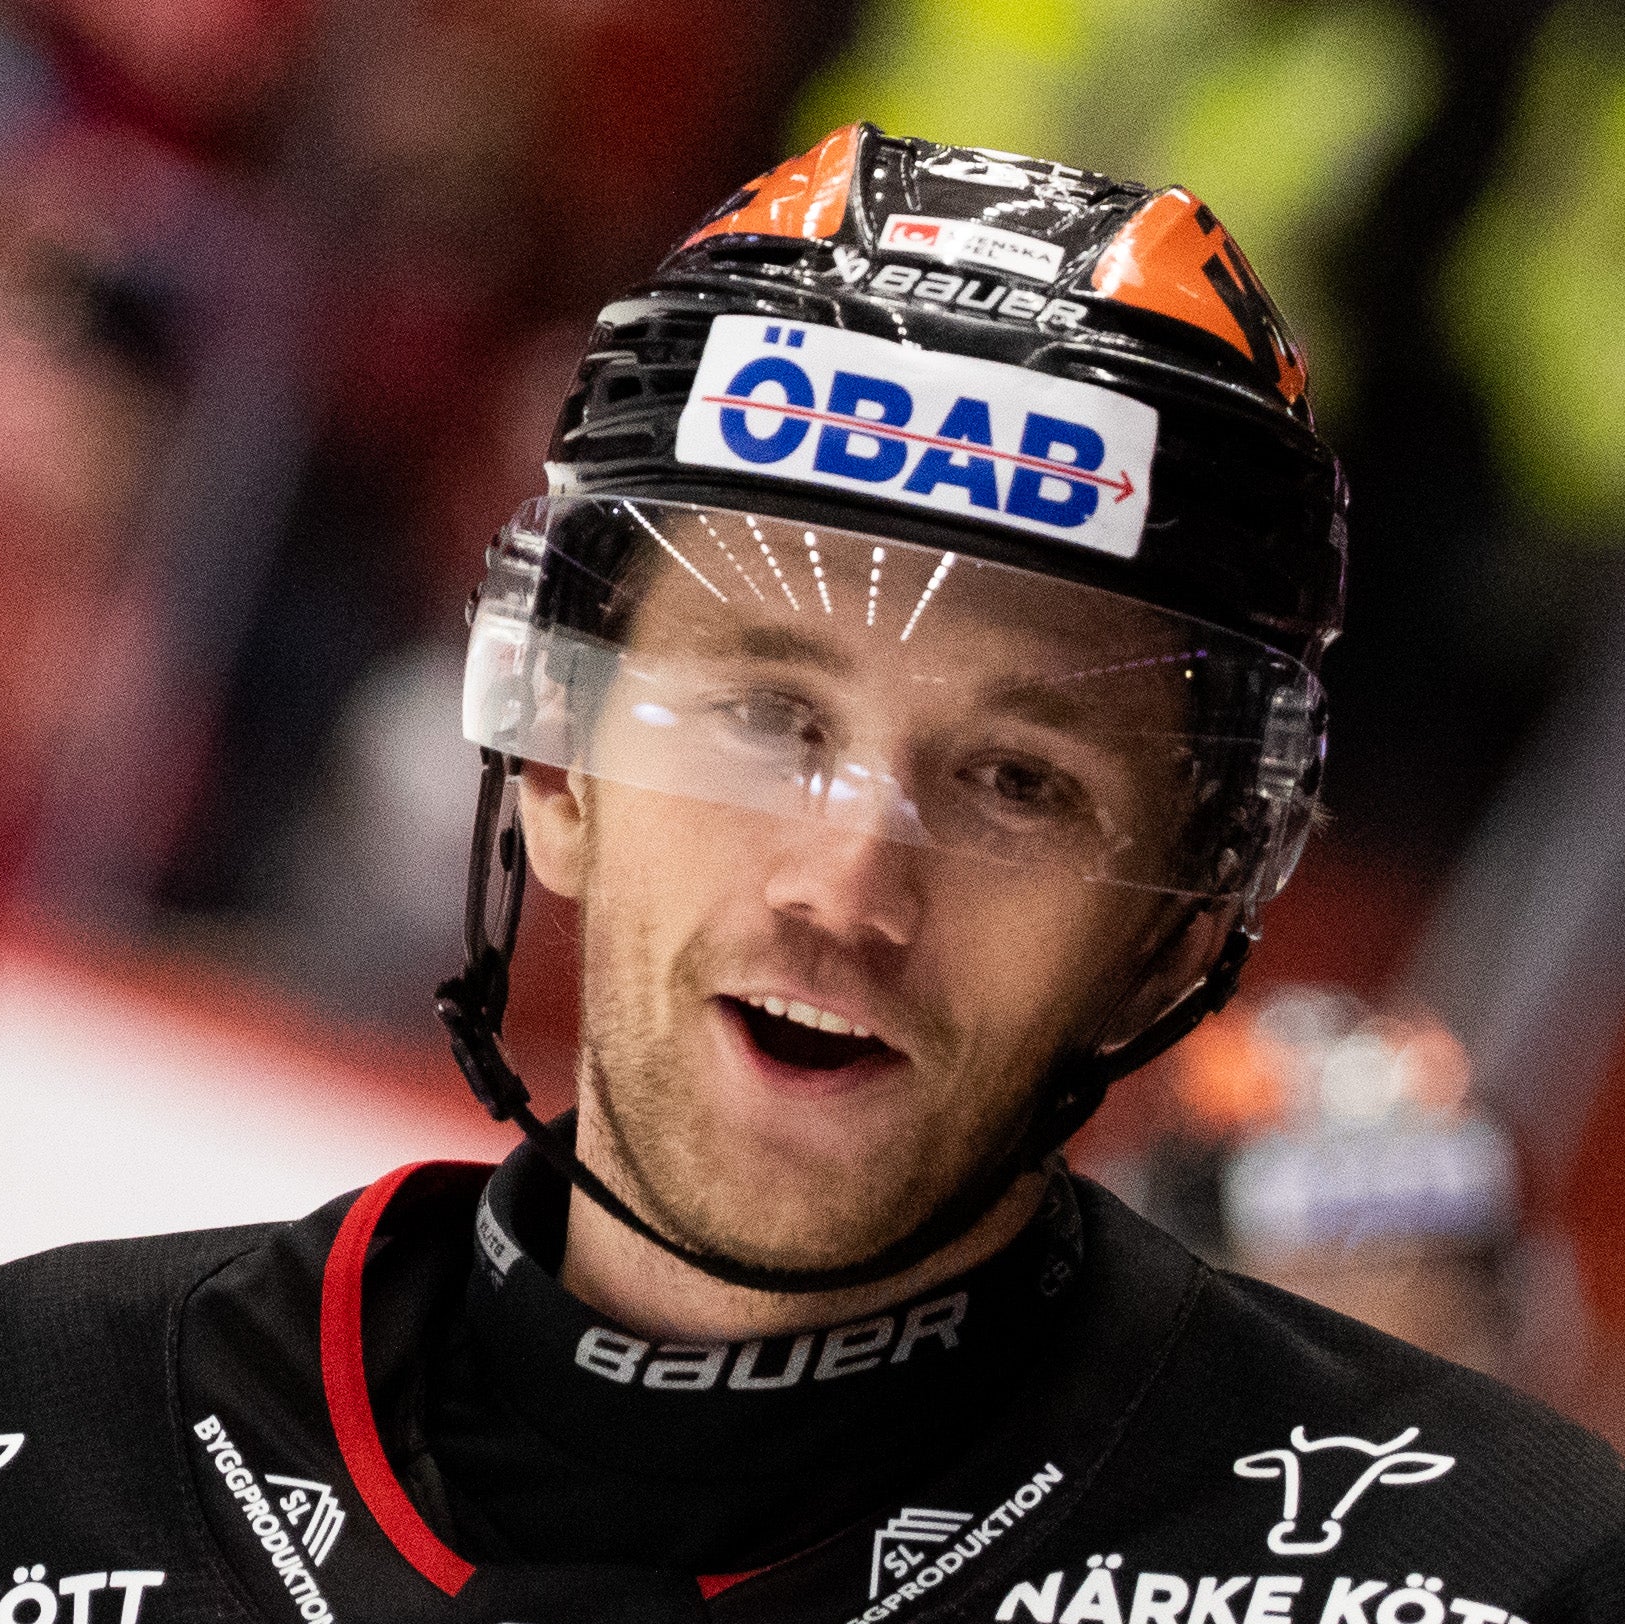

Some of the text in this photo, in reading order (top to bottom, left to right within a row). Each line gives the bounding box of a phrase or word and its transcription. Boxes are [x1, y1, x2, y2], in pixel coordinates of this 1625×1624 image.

[718, 325, 1106, 529] ÖBAB
[278, 1488, 308, 1526] SL
[881, 1543, 925, 1579] SL
